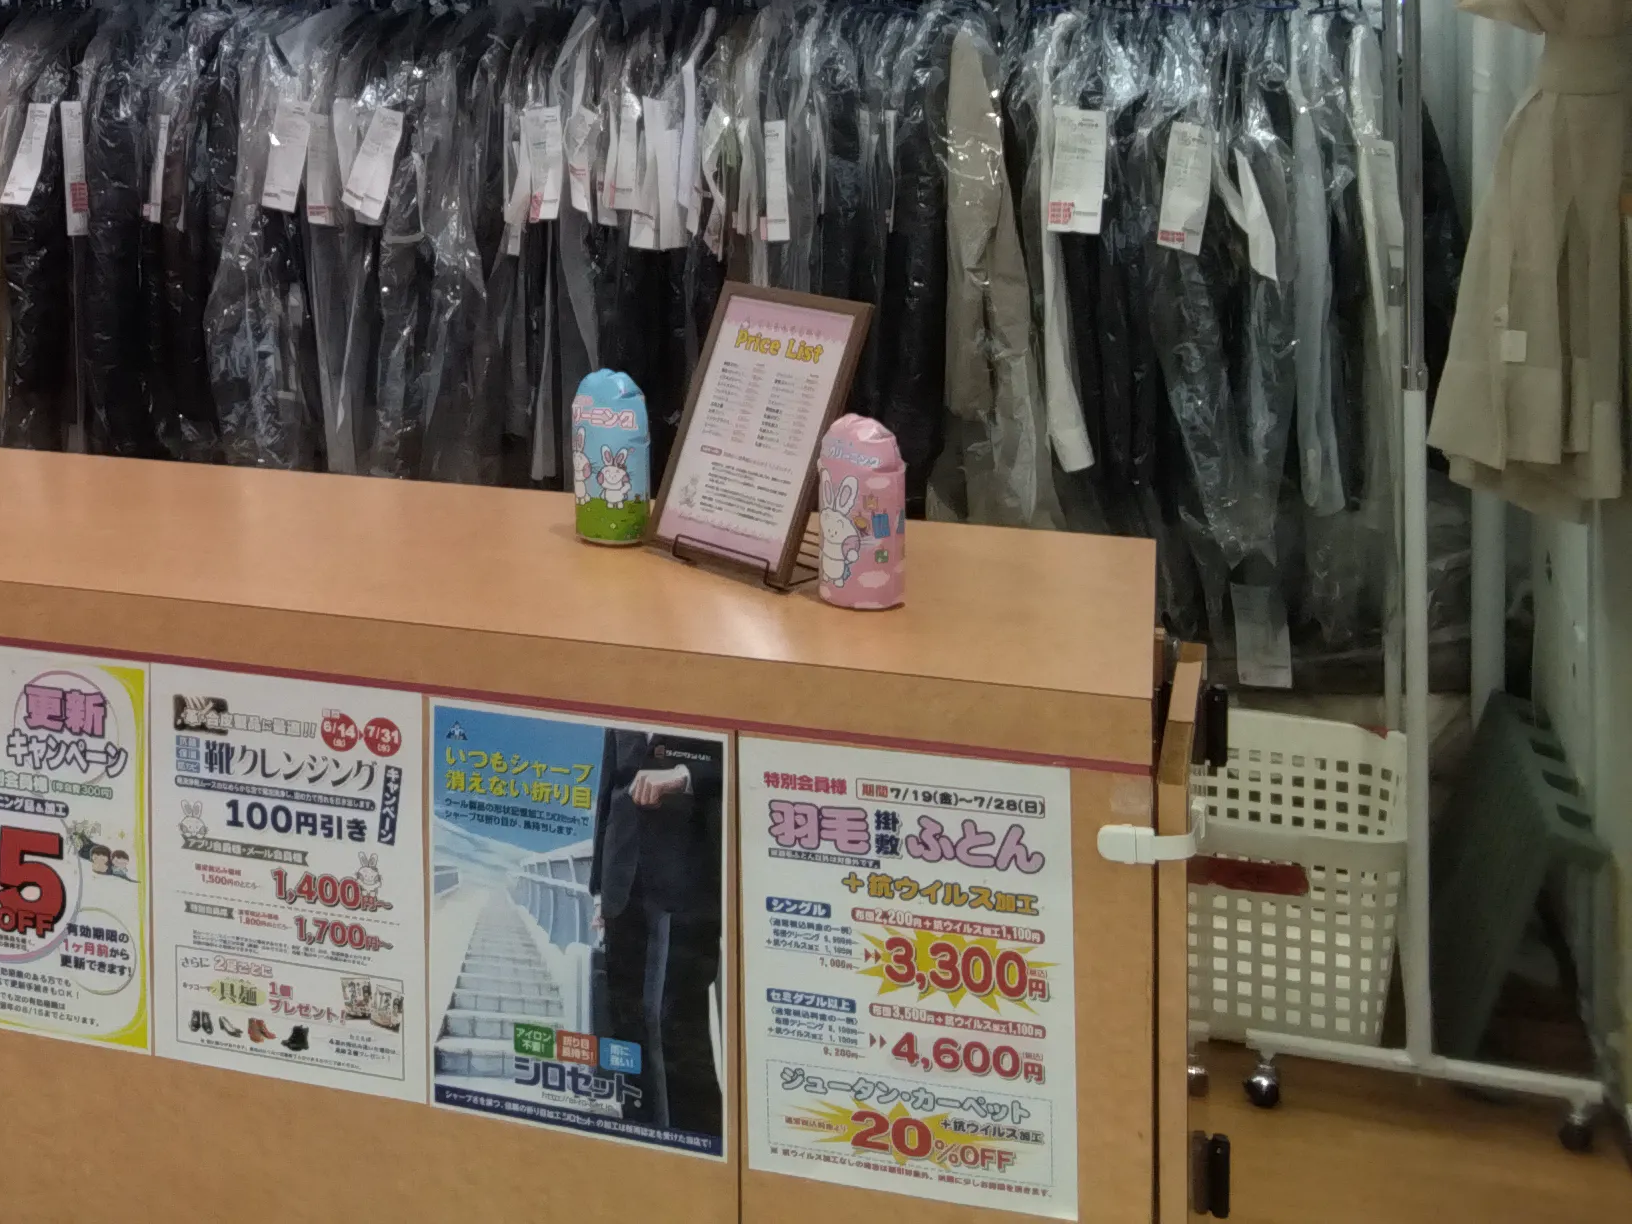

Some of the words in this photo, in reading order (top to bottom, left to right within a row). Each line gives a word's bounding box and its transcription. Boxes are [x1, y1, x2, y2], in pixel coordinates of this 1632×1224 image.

[734, 328, 780, 356] Price
[785, 338, 825, 364] List
[24, 683, 108, 739] 更新
[6, 728, 128, 778] キャンペーン
[367, 725, 400, 744] 7/31
[204, 739, 377, 791] 靴クレンジング
[445, 746, 595, 783] いつもシャープ
[764, 771, 848, 796] 特別会員様
[379, 767, 400, 842] キャンペーン
[445, 769, 592, 810] 消えない折り目
[226, 799, 367, 842] 100円引き
[768, 799, 871, 855] 羽毛
[905, 815, 1046, 874] ふとん
[771, 898, 827, 916] シングル
[67, 923, 130, 943] 有効期限の
[60, 954, 132, 977] 更新できます!
[180, 957, 210, 969] さらに
[884, 936, 1049, 1001] 3,300円
[268, 998, 347, 1025] プレゼント!
[771, 990, 851, 1012] セミダブル以上
[516, 1027, 552, 1043] アイロン
[891, 1032, 1047, 1085] 4,600円
[514, 1057, 642, 1108] シロセット
[780, 1067, 1032, 1125] ジュータン・カーペット
[850, 1110, 934, 1160] 20
[934, 1139, 1016, 1171] %OFF
